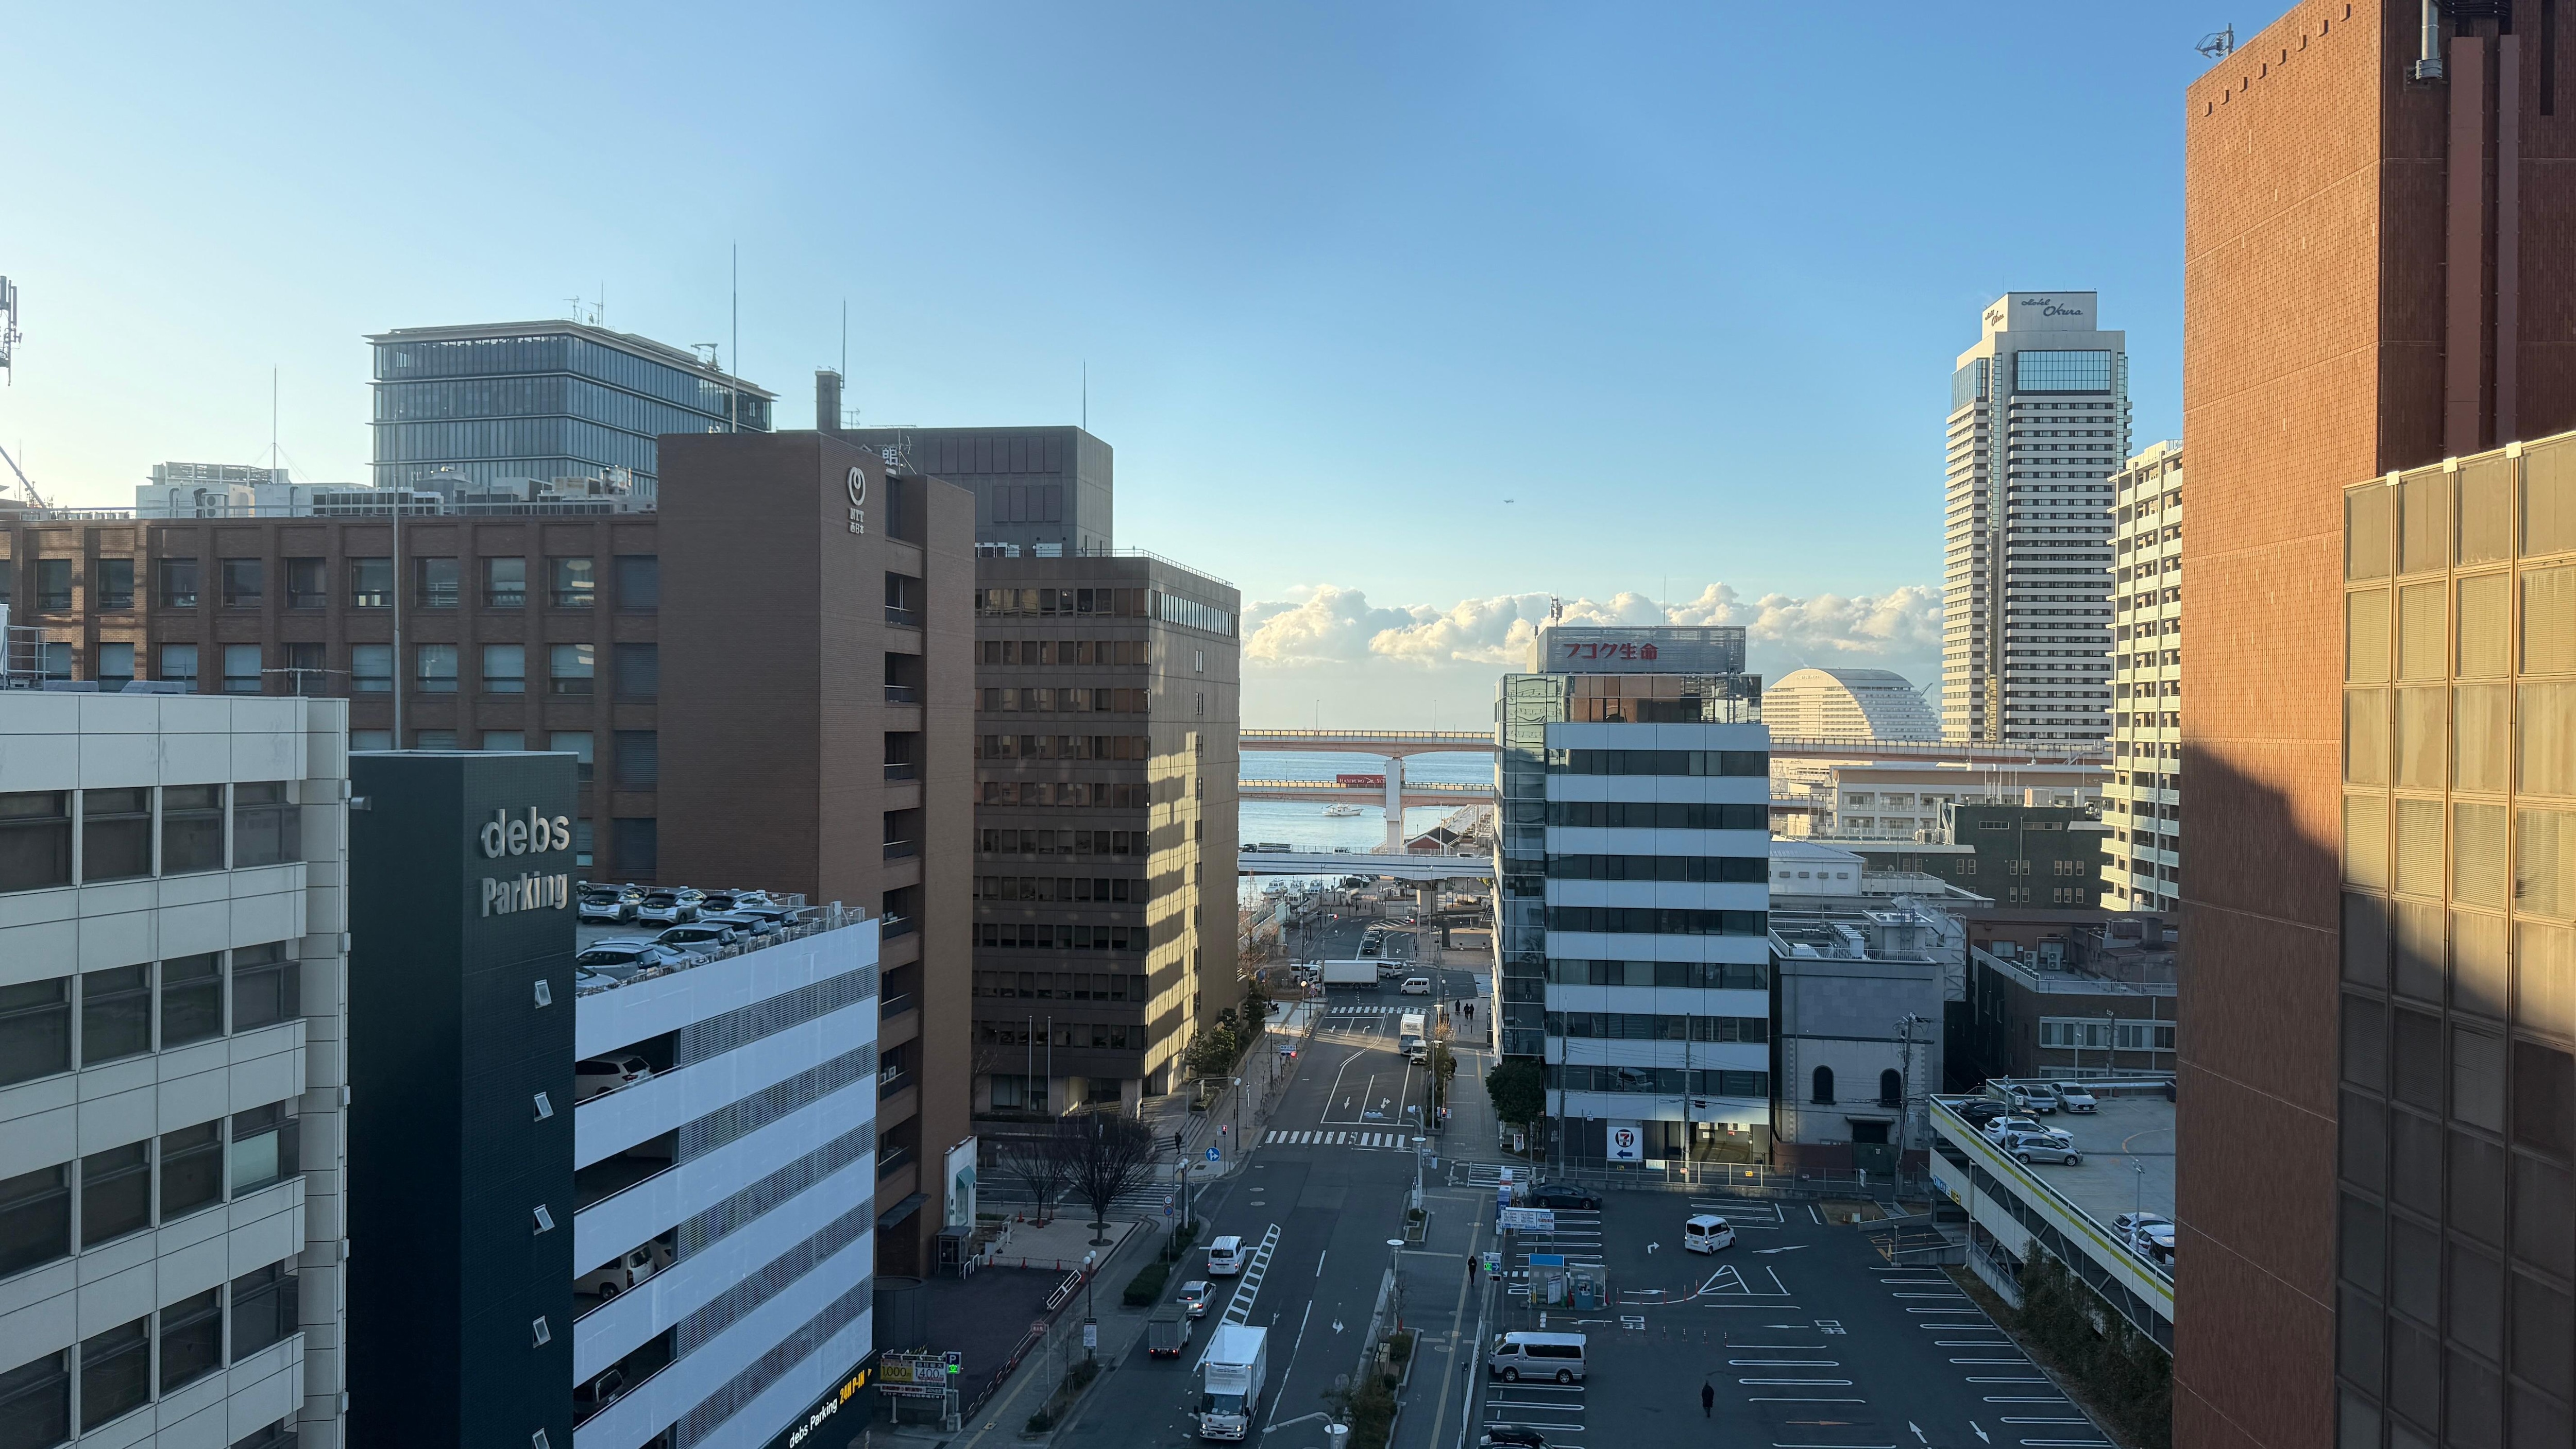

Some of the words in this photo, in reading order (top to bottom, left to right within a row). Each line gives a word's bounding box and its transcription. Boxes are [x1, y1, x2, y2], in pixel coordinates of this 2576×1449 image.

[2043, 303, 2083, 316] Okura
[850, 507, 864, 522] NTT
[1563, 643, 1658, 660] フコク生命
[481, 806, 570, 859] debs
[482, 871, 568, 917] Parking
[950, 1355, 957, 1363] P
[789, 1425, 808, 1448] debs
[810, 1398, 837, 1430] Parking
[839, 1380, 852, 1405] 24H
